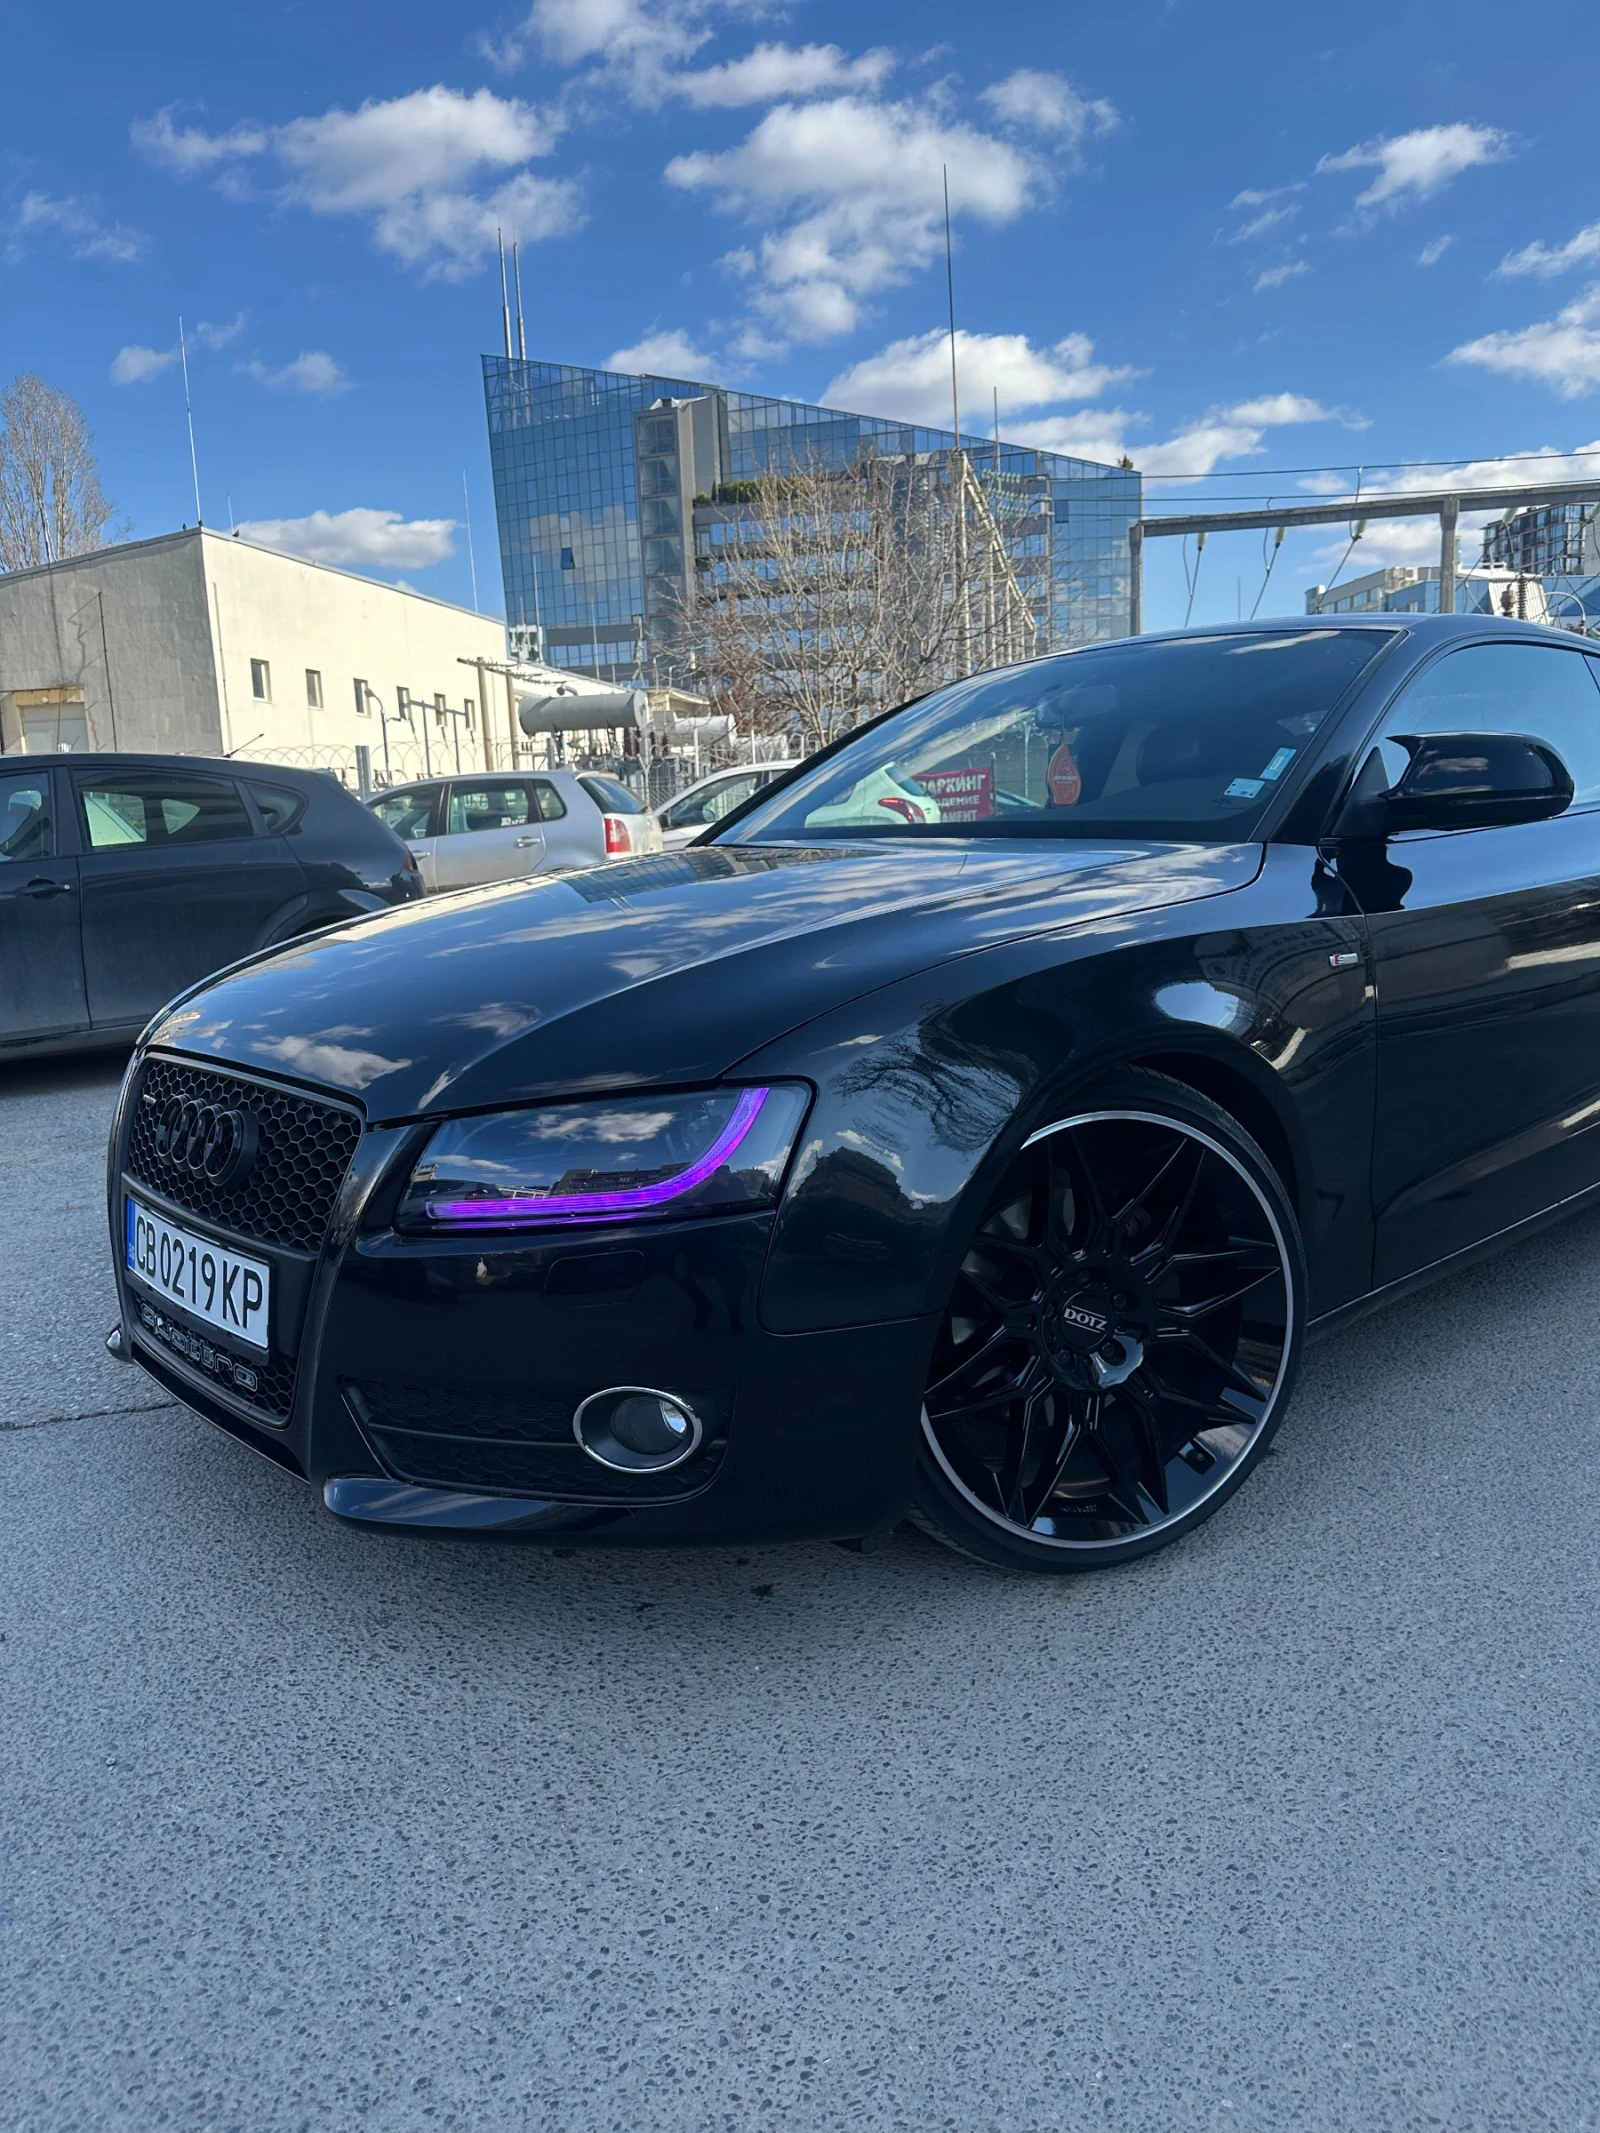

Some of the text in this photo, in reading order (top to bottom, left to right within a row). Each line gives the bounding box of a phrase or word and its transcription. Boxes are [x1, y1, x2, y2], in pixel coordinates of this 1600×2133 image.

[942, 810, 977, 823] АМЕНТ
[1064, 1308, 1107, 1331] DOTZ
[141, 1303, 258, 1393] quattro
